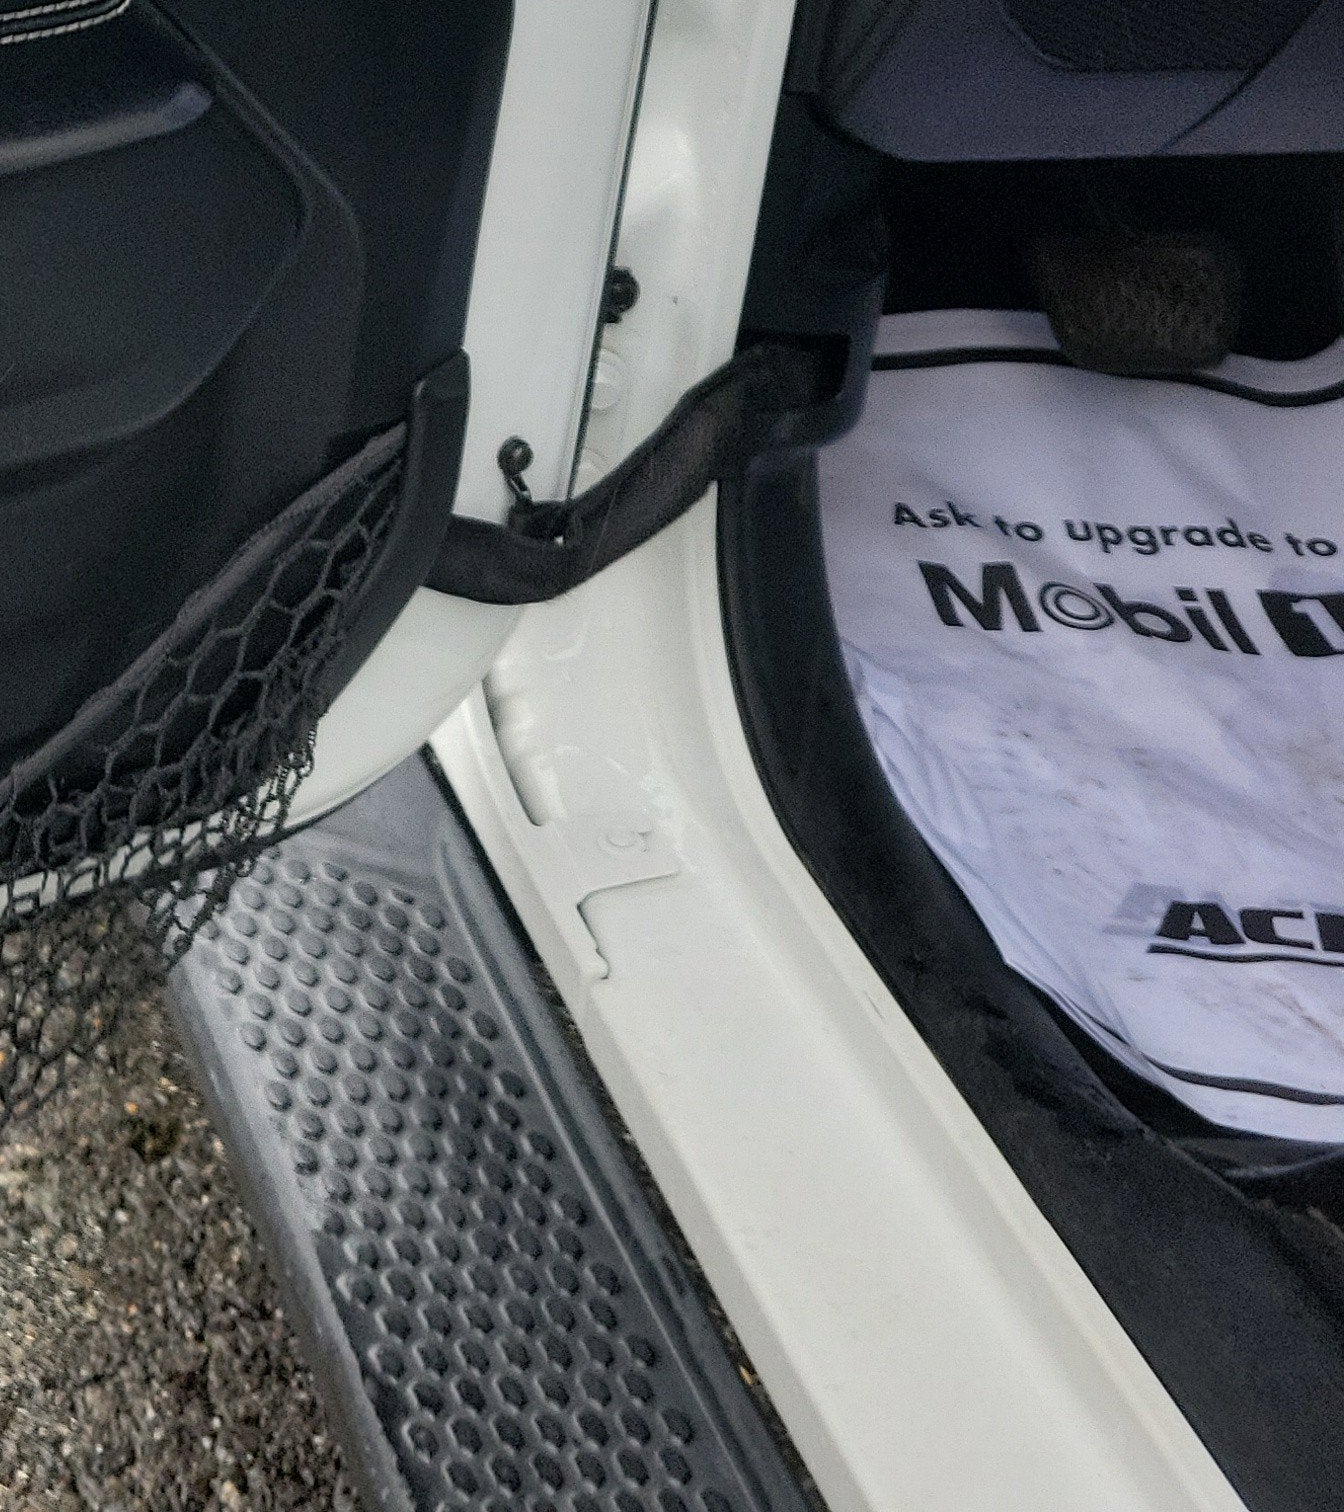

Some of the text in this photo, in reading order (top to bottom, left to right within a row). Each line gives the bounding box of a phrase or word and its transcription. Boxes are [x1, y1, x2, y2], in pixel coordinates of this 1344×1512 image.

[892, 501, 1338, 557] Ask to upgrade to
[916, 560, 1261, 656] Mobil
